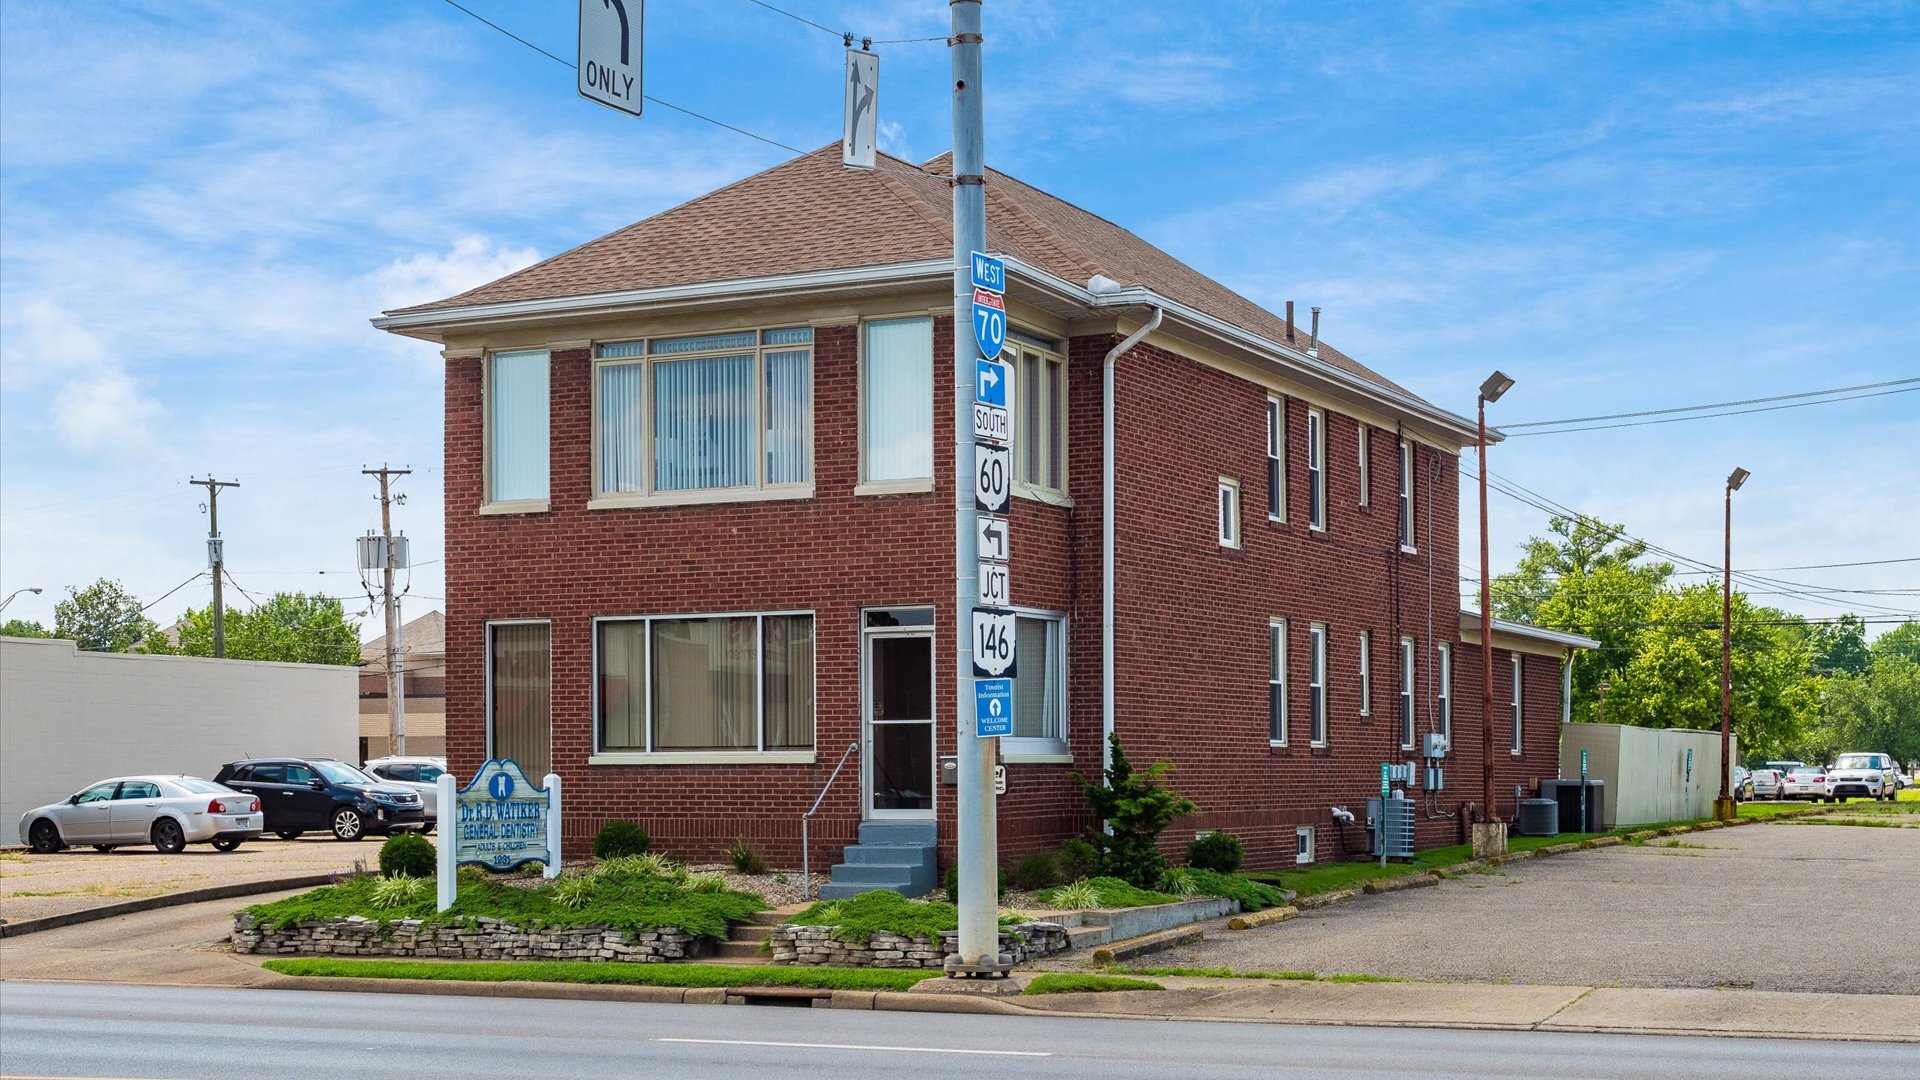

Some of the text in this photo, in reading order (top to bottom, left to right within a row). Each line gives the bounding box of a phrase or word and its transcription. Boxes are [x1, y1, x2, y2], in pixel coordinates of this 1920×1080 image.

[587, 60, 634, 100] ONLY
[976, 257, 1000, 285] WEST
[977, 294, 1001, 308] INTERSTATE
[978, 309, 1002, 344] 70
[976, 409, 1006, 434] SOUTH
[980, 458, 1002, 495] 60
[982, 571, 1005, 599] JCT
[980, 623, 1009, 660] 146
[978, 691, 1010, 699] Information
[981, 716, 1009, 724] WELCOME
[984, 724, 1007, 732] CENTER
[496, 801, 540, 820] WATIKER
[463, 822, 539, 840] GENERAL DENTISTRY
[477, 842, 496, 851] ADULTS
[503, 840, 527, 850] CHILDREN
